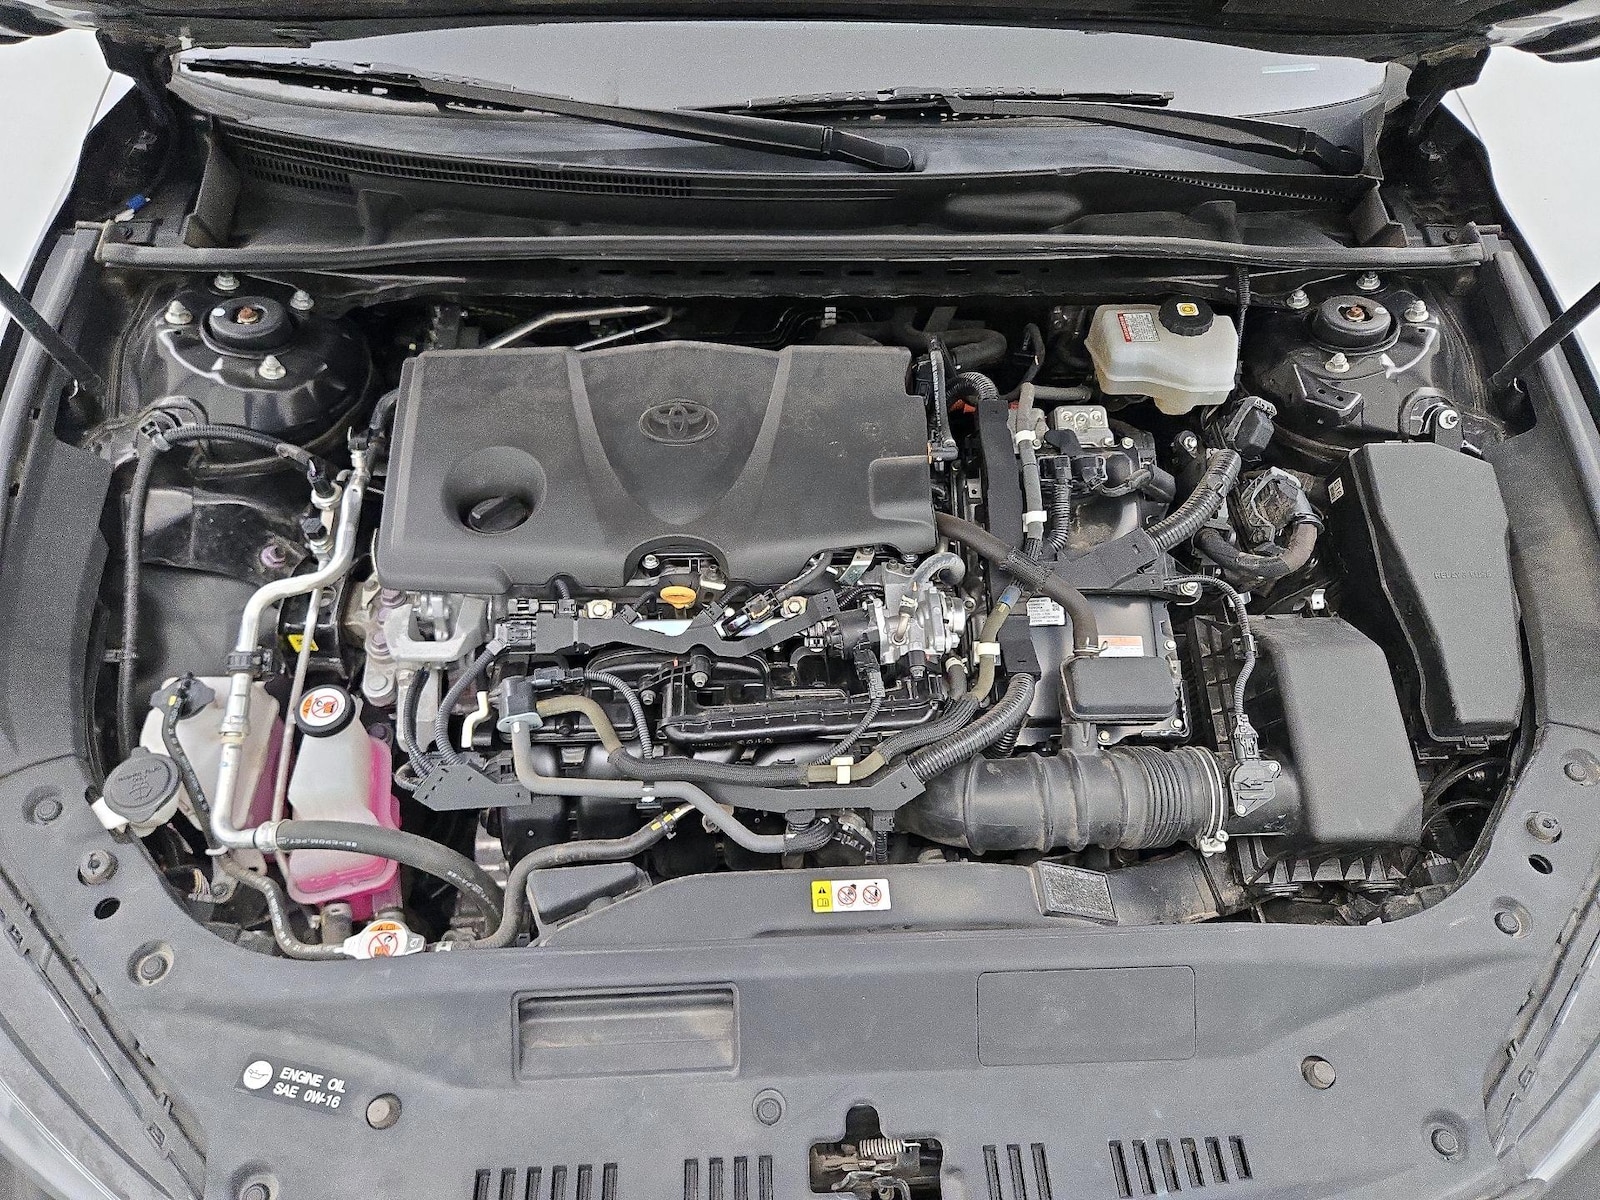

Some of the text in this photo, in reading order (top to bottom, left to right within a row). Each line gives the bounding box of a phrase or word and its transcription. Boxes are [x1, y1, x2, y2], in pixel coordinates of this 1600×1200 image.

[279, 1066, 346, 1094] ENGINE OIL
[272, 1082, 341, 1109] SAE 0W-16
